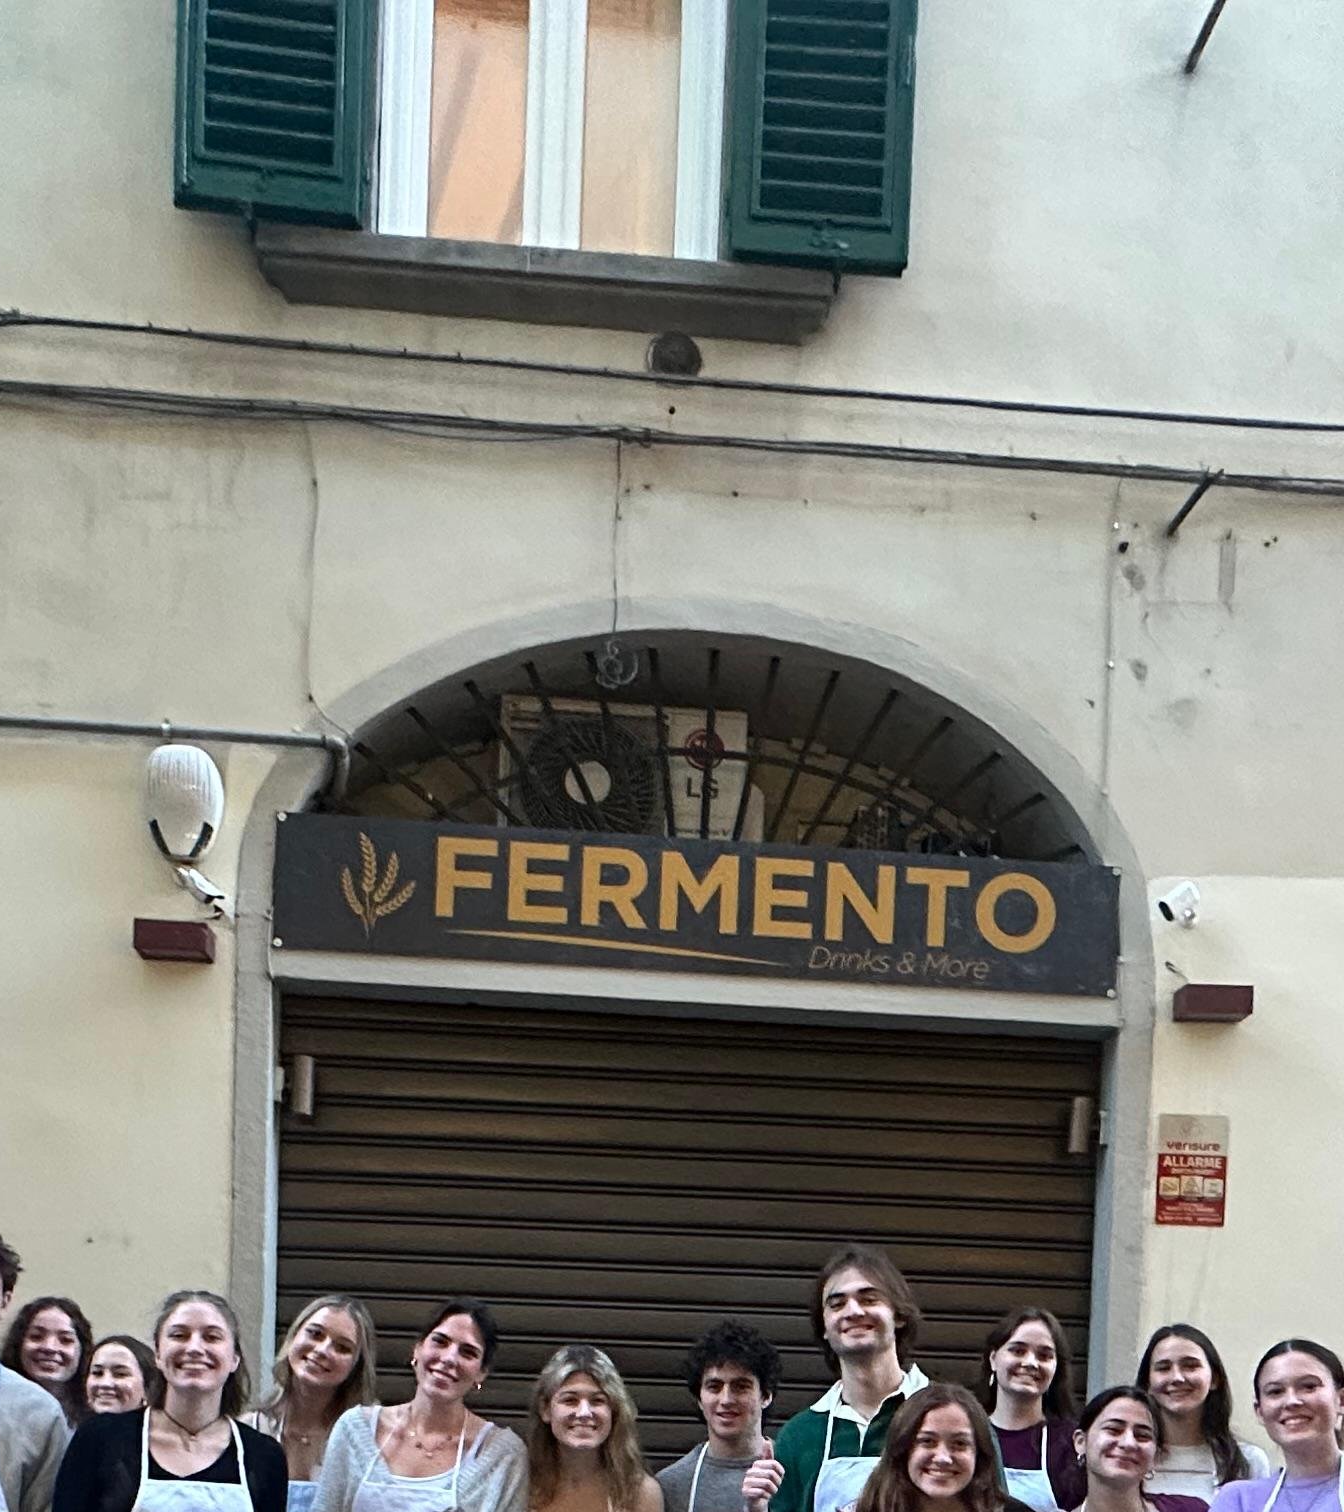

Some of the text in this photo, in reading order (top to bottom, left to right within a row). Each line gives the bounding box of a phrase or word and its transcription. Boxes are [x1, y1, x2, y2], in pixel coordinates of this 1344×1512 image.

[434, 835, 1057, 953] FERMENTO
[808, 946, 989, 980] Drinks & More
[1167, 1141, 1221, 1151] verisure
[1163, 1156, 1223, 1168] ALLARME
